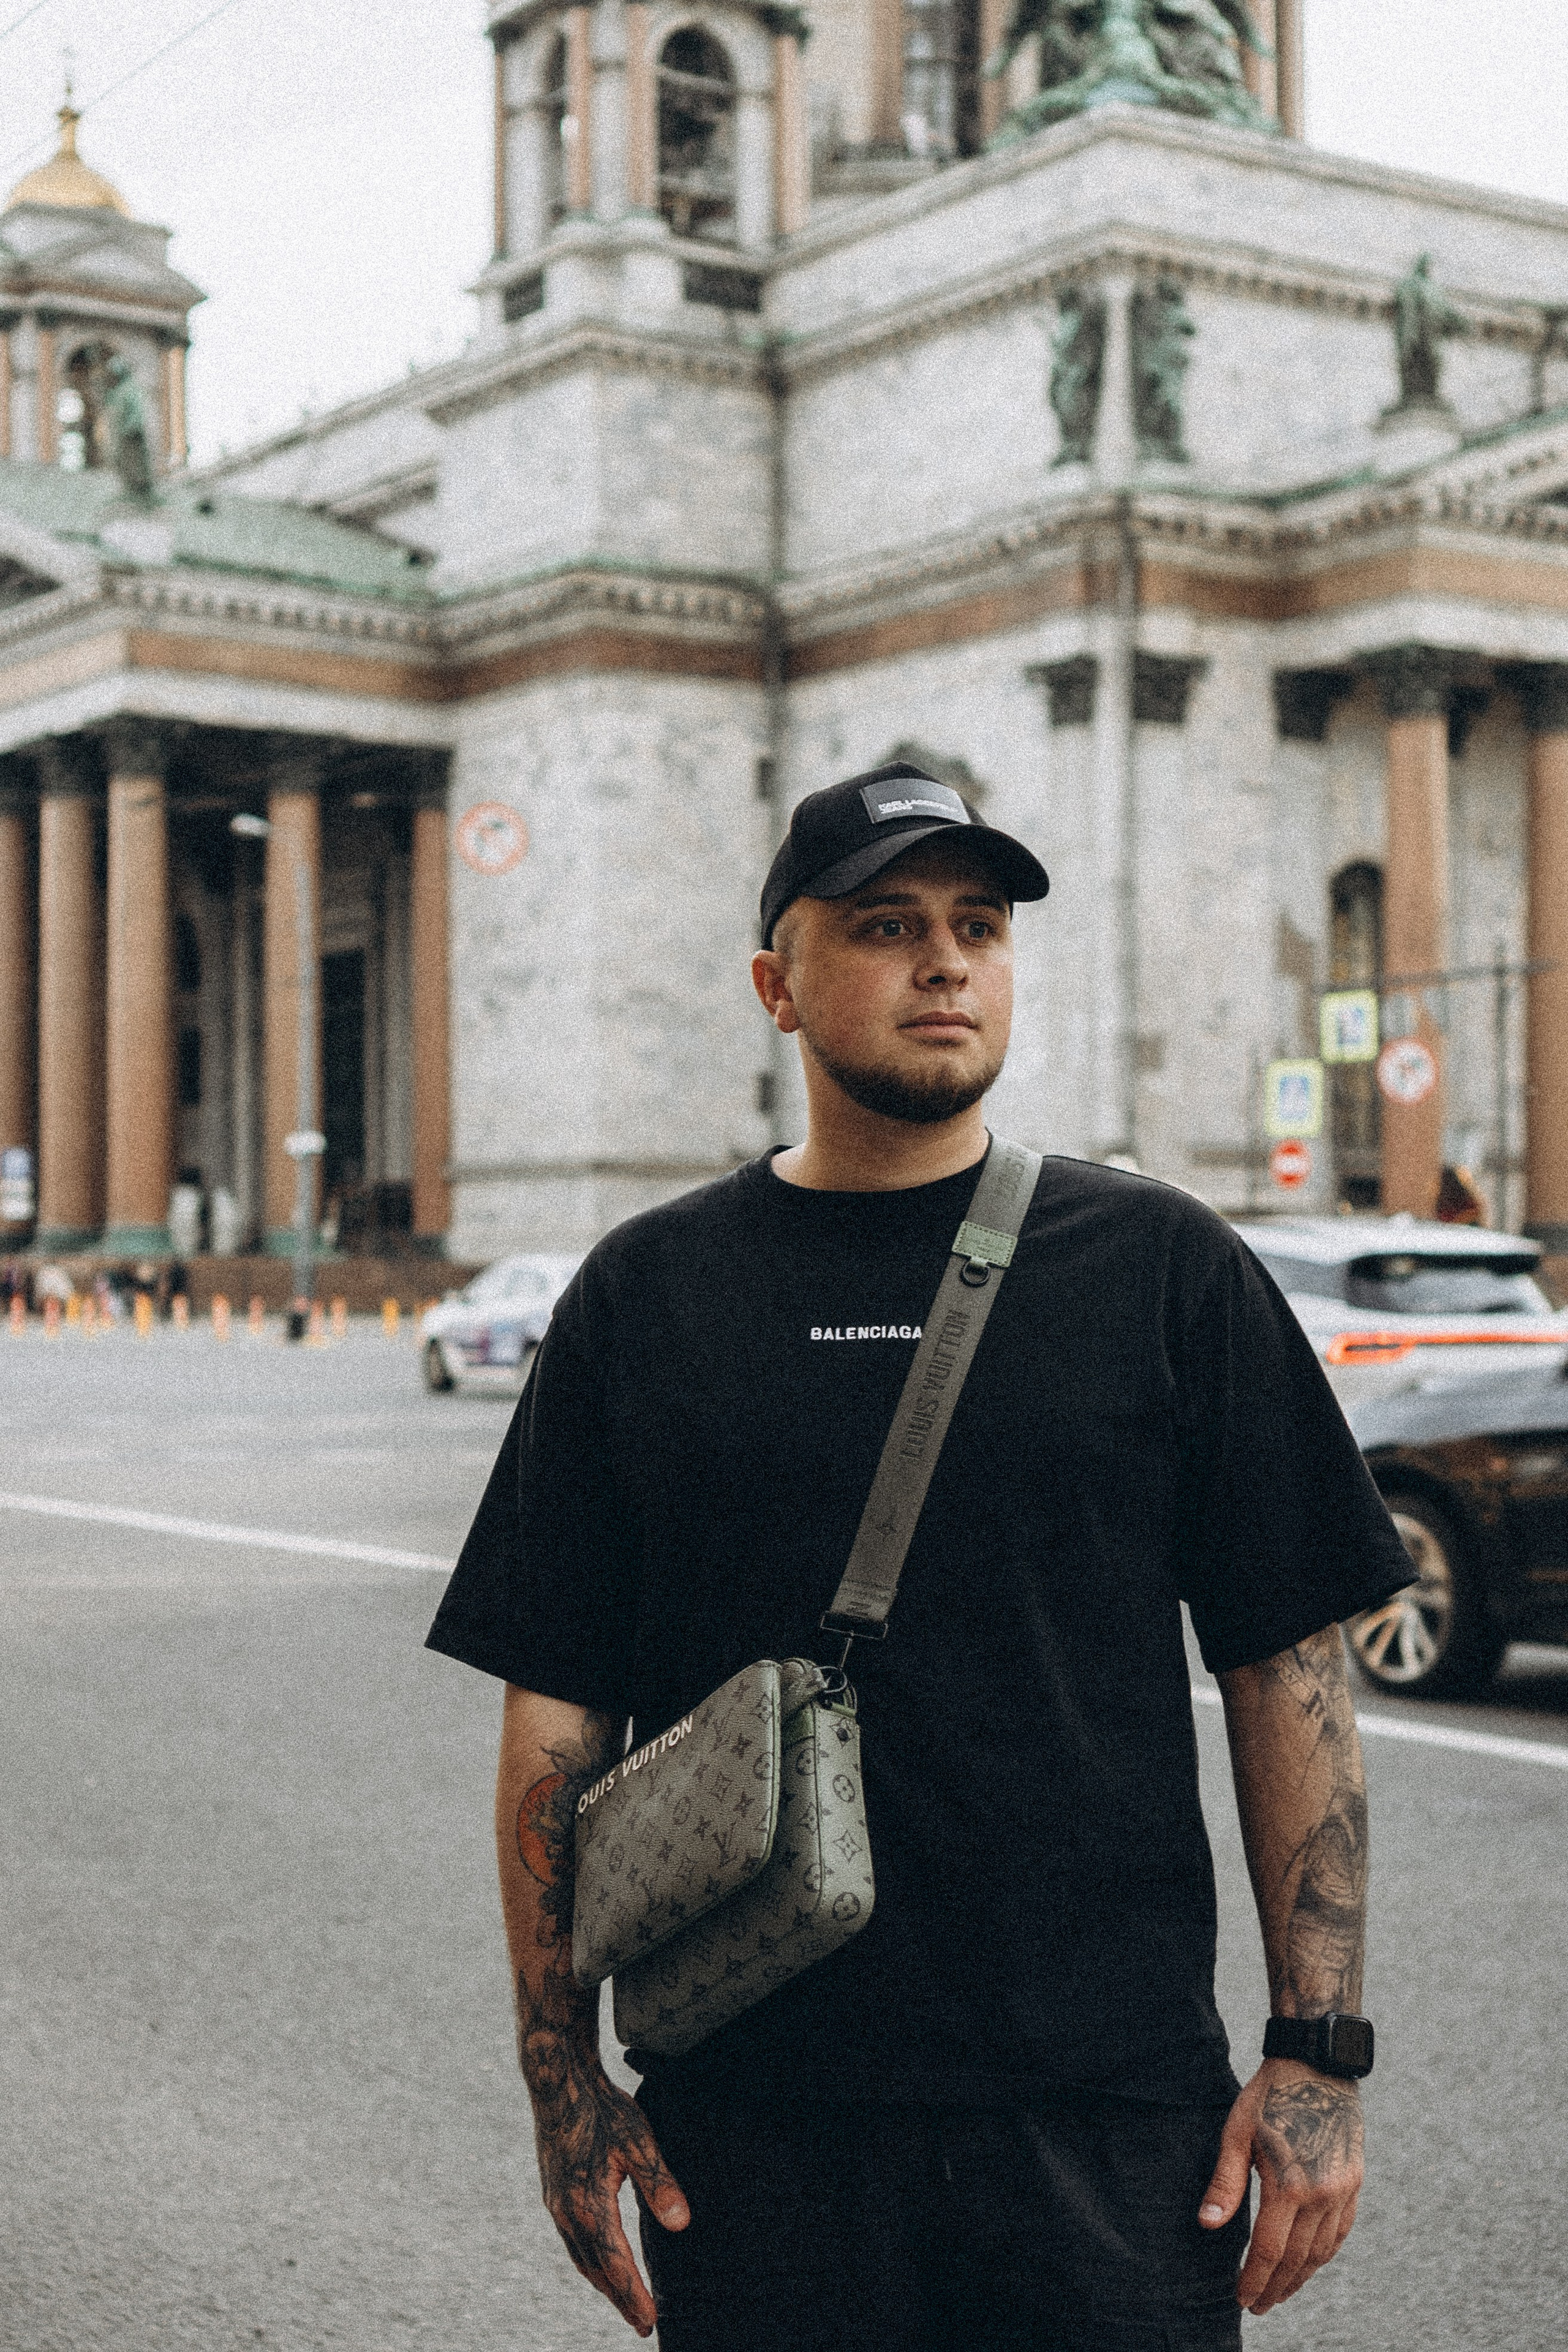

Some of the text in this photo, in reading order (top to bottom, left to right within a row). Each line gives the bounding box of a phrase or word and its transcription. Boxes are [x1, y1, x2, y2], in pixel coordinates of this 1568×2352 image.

[810, 1325, 922, 1340] BALENCIAGA
[900, 1309, 970, 1460] LOUIS VUITTON
[576, 1769, 616, 1817] OUIS
[622, 1714, 693, 1777] VUITTON
